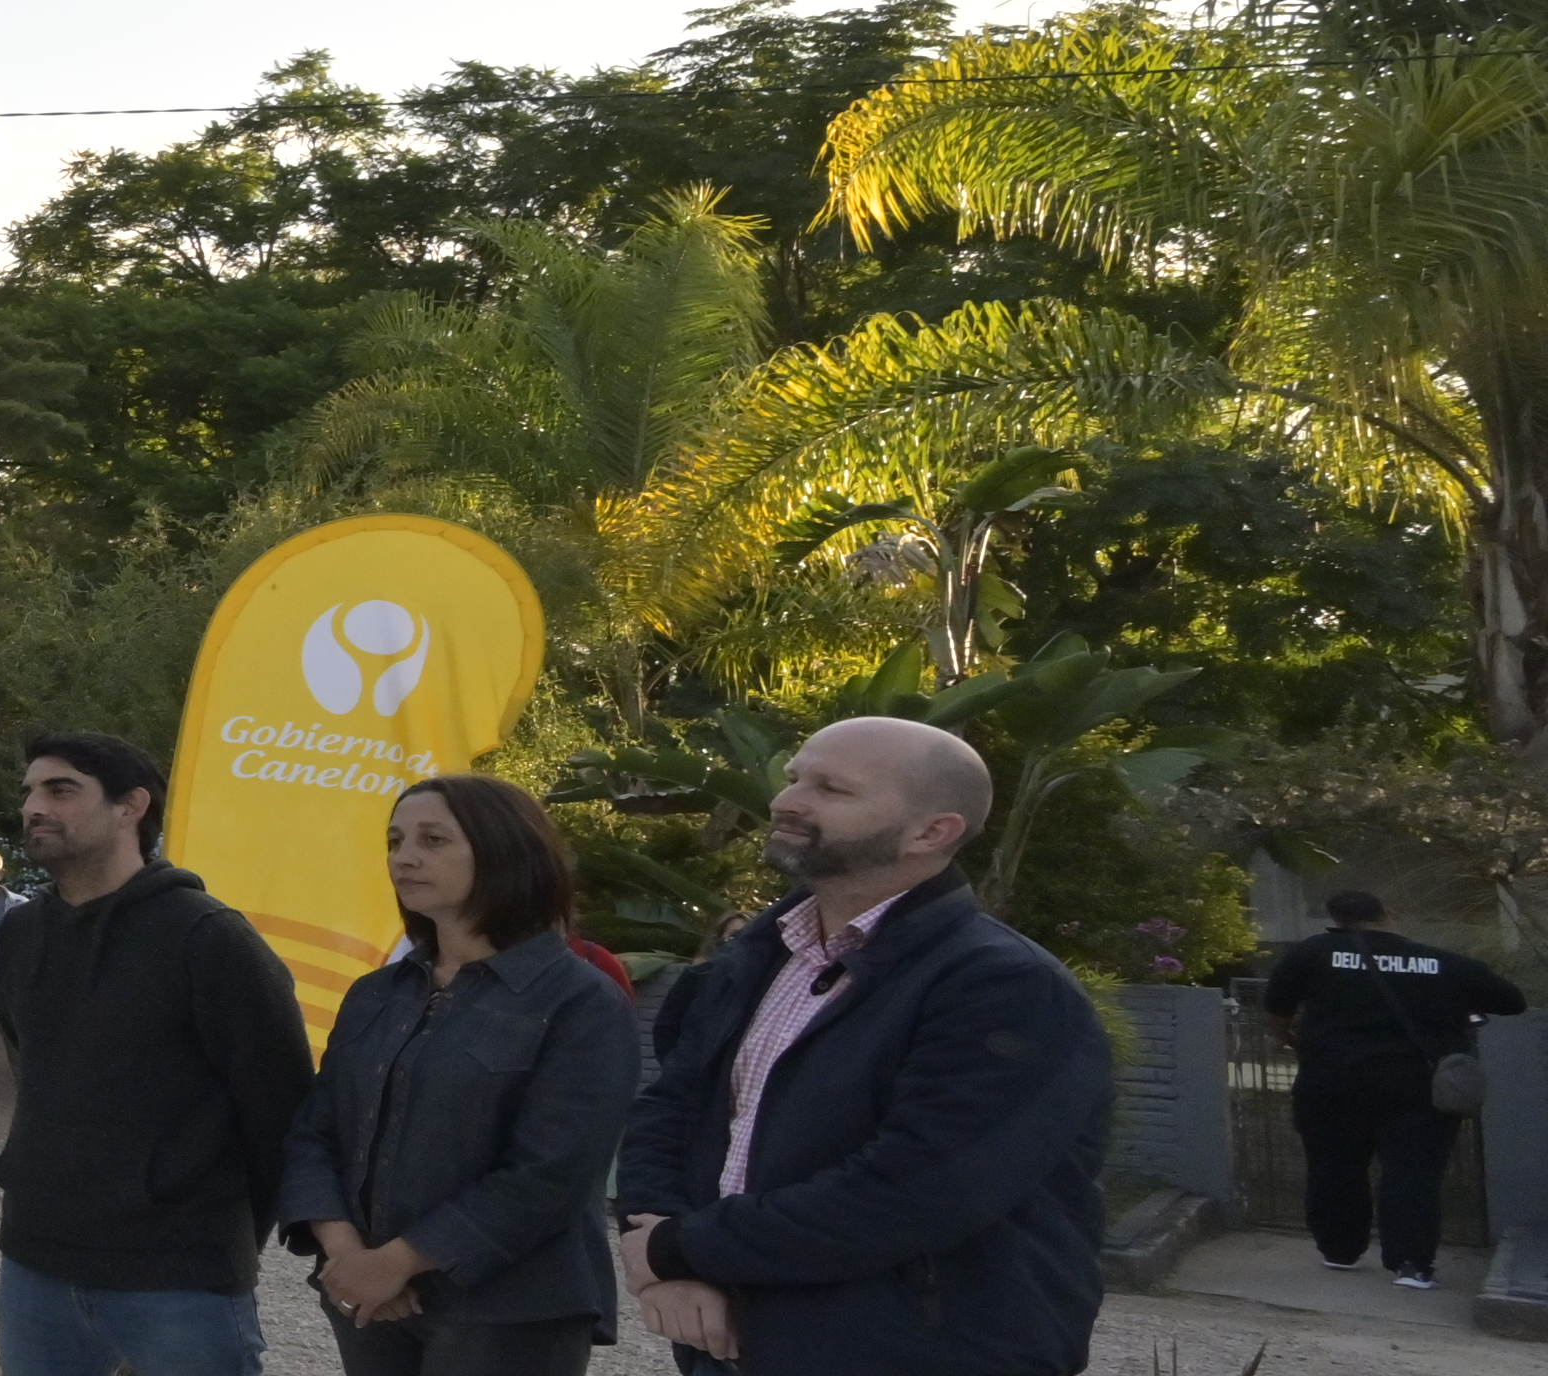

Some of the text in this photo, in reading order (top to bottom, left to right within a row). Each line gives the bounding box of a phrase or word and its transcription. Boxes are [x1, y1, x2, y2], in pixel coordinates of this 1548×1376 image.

[221, 715, 404, 762] Gobierno
[231, 749, 407, 796] Canelon
[1332, 951, 1438, 974] DEUCHLAND
